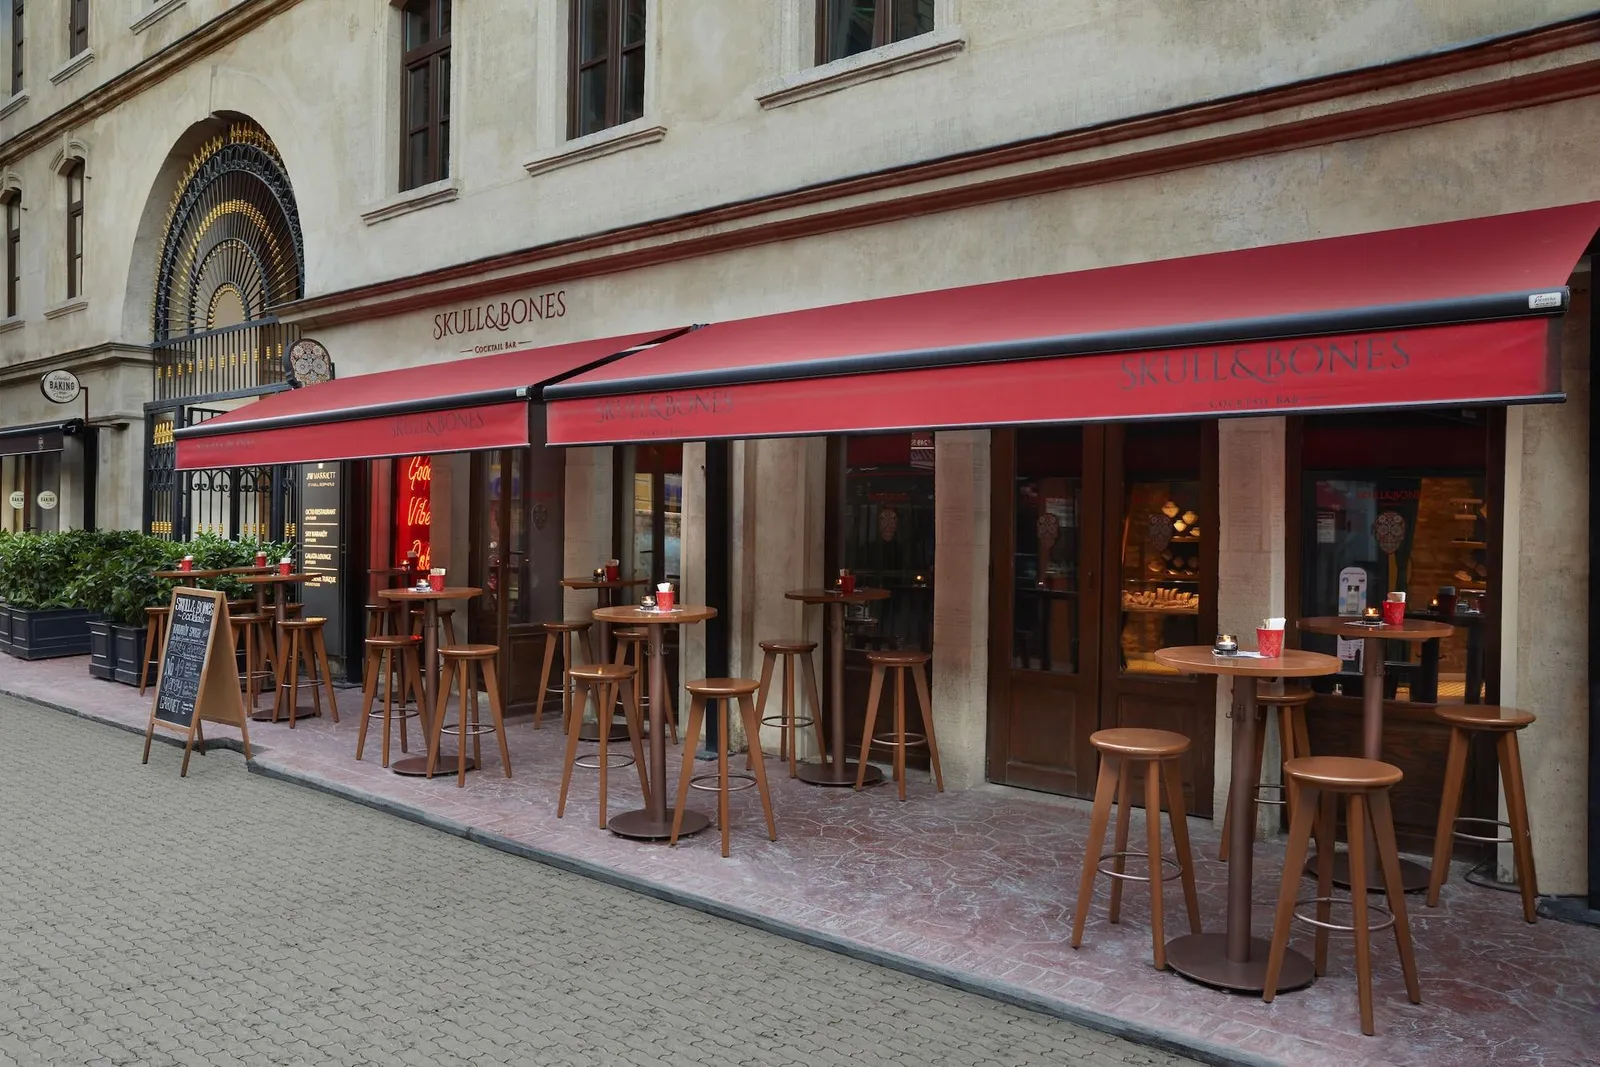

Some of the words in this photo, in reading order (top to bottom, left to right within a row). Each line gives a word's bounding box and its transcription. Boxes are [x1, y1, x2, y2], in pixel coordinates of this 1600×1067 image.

[433, 290, 566, 340] SKULL&BONES
[505, 340, 517, 350] BAR
[49, 380, 75, 391] BAKING
